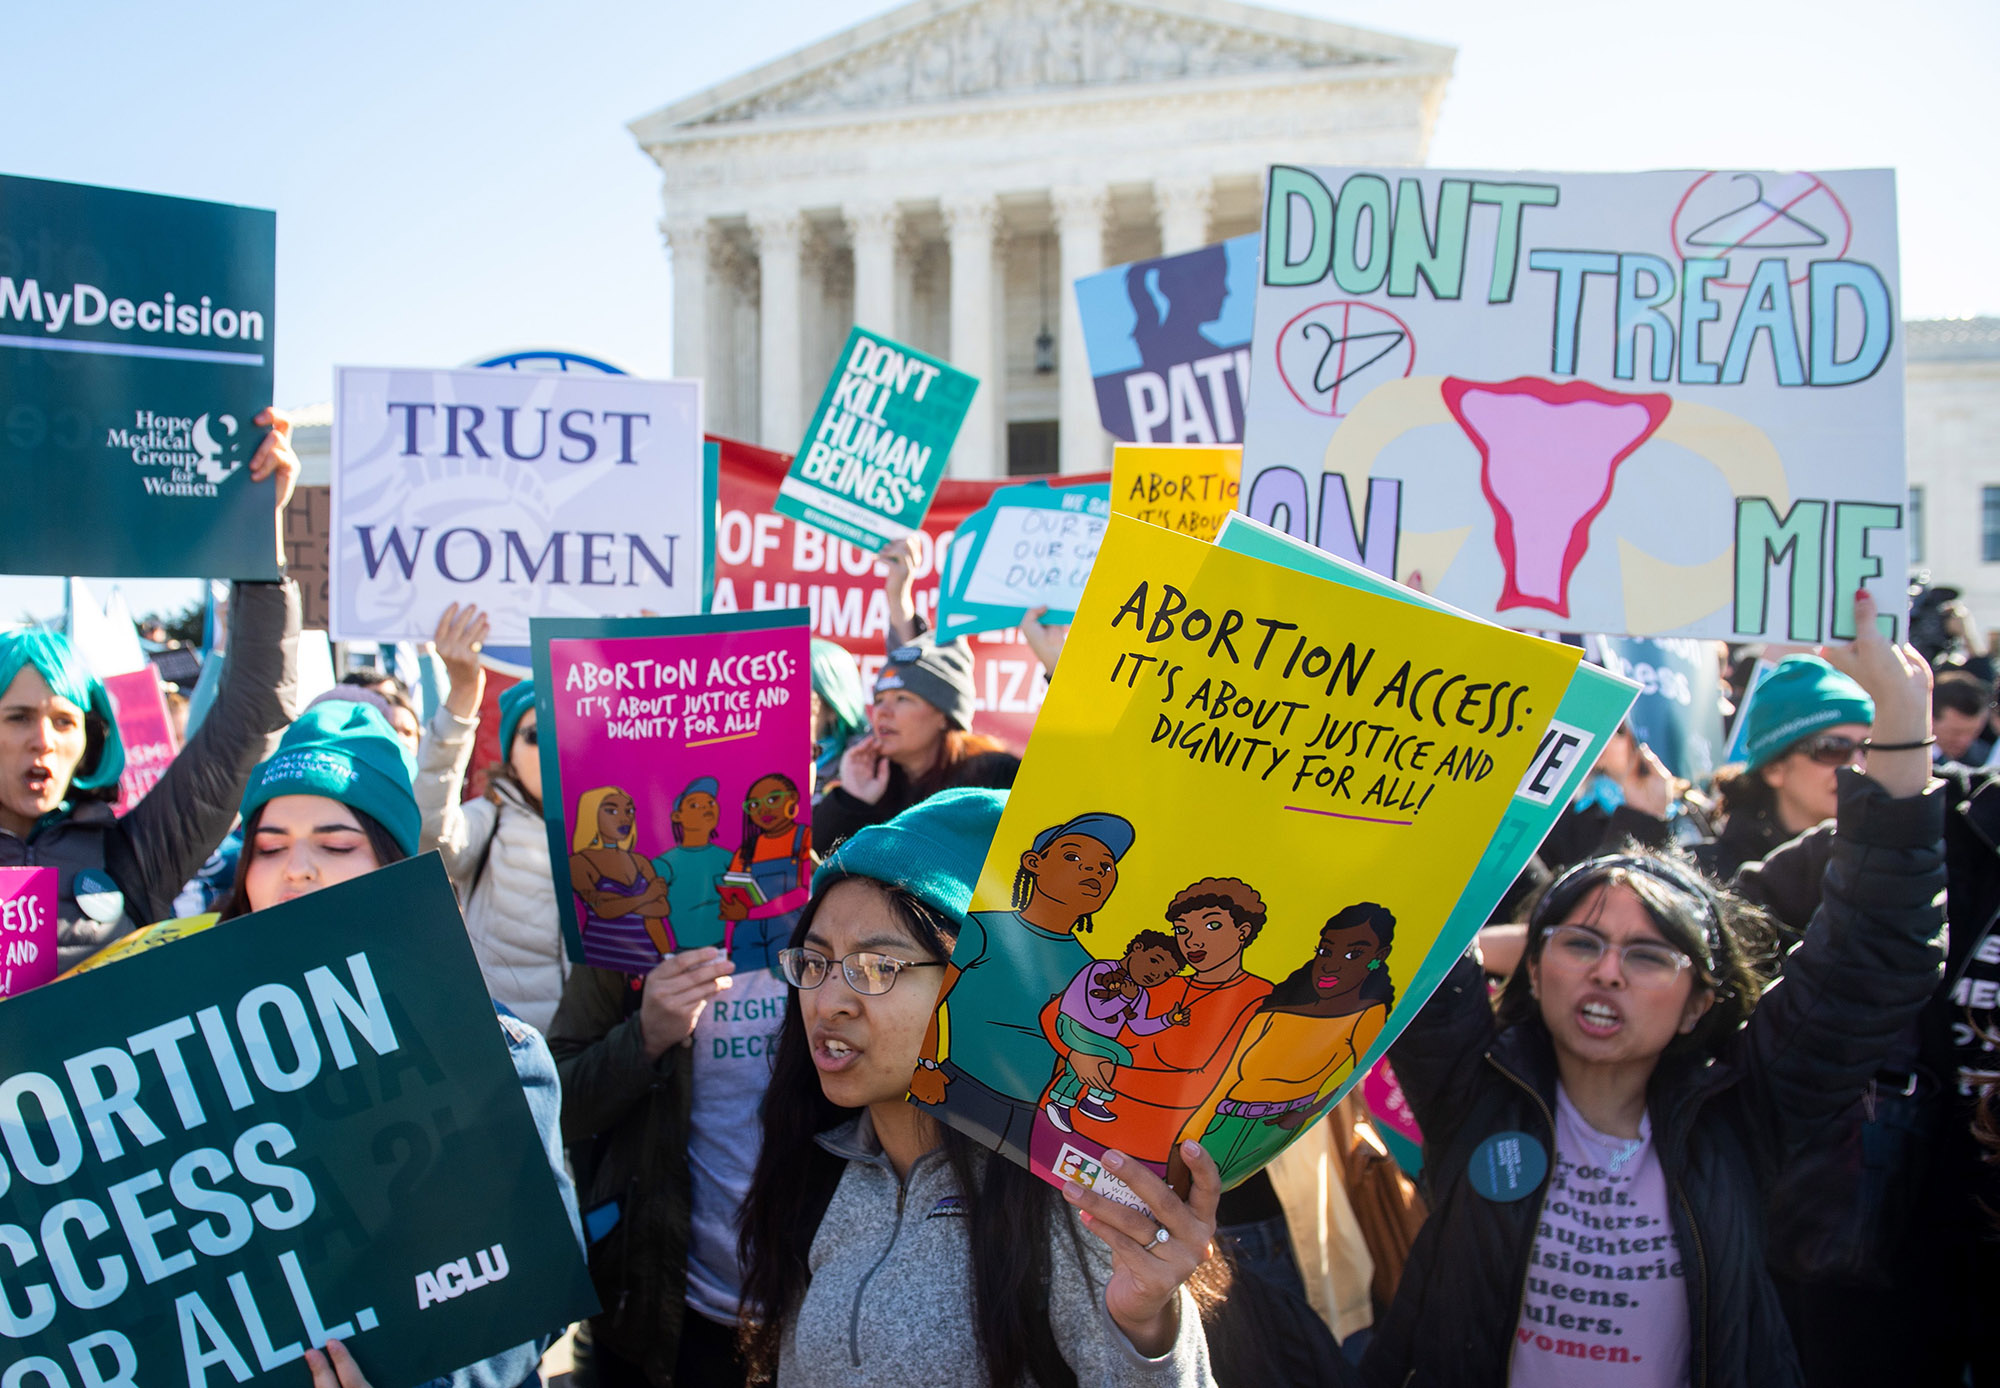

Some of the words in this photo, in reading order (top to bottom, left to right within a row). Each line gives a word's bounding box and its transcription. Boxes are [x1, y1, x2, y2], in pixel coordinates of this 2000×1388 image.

[1264, 165, 1560, 305] DONT
[1529, 249, 1893, 387] TREAD
[831, 371, 891, 428] KILL
[846, 336, 941, 402] DON'T
[106, 428, 191, 450] Medical
[136, 410, 193, 434] Hope
[387, 402, 650, 465] TRUST
[816, 405, 932, 482] HUMAN
[132, 446, 199, 472] Group
[143, 477, 218, 497] Women
[171, 466, 196, 483] for
[718, 509, 785, 568] OF
[1246, 466, 1402, 581] ON
[353, 525, 680, 588] WOMEN
[1733, 496, 1904, 644] ME
[565, 658, 698, 693] ABORTION
[706, 649, 796, 687] ACCESS:
[1111, 580, 1375, 696] ABORTION
[1373, 659, 1532, 737] ACCESS:
[576, 695, 611, 718] IT'S
[617, 693, 678, 718] ABOUT
[682, 690, 751, 716] JUSTICE
[755, 686, 790, 709] AND
[607, 717, 678, 740] DIGNITY
[685, 715, 719, 739] FOR
[723, 710, 762, 733] ALL!
[1110, 653, 1183, 702] IT'S
[1185, 678, 1310, 736] ABOUT
[1305, 713, 1435, 770] JUSTICE
[1434, 745, 1494, 782] AND
[1151, 713, 1290, 781] DIGNITY
[1292, 755, 1354, 799] FOR
[1361, 774, 1435, 815] ALL!
[5, 939, 39, 967] AND
[714, 996, 788, 1022] RIGHT
[0, 952, 400, 1194] ORTION
[1544, 1199, 1660, 1232] others.
[415, 1243, 510, 1311] ACLU
[175, 1250, 380, 1388] ALL.
